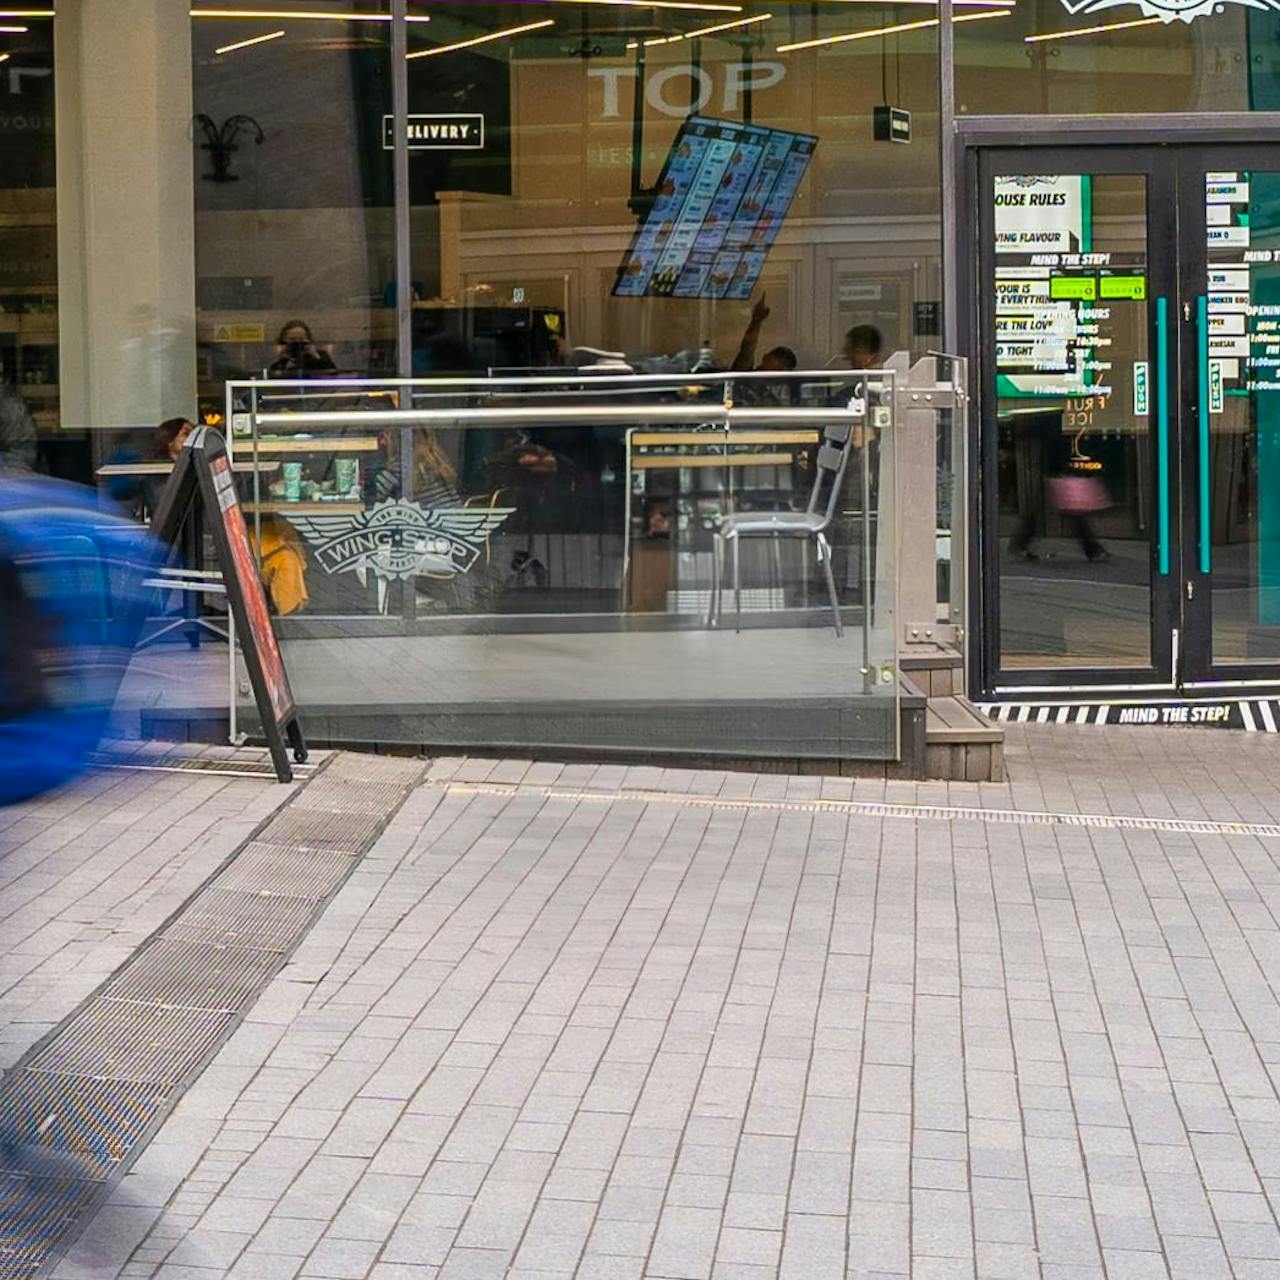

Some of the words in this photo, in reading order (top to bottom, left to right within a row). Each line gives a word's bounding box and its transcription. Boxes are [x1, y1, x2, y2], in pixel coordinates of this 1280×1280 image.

[406, 124, 470, 139] ELIVERY
[1029, 193, 1067, 206] RULES
[1020, 232, 1061, 243] FLAVOUR
[1030, 254, 1059, 266] MIND
[1061, 254, 1081, 266] THE
[1243, 250, 1272, 261] MIND
[1022, 284, 1031, 294] IS
[1007, 346, 1034, 356] TIGHT
[1119, 707, 1159, 724] MIND
[1161, 706, 1189, 723] THE
[1190, 705, 1231, 722] STEP!
